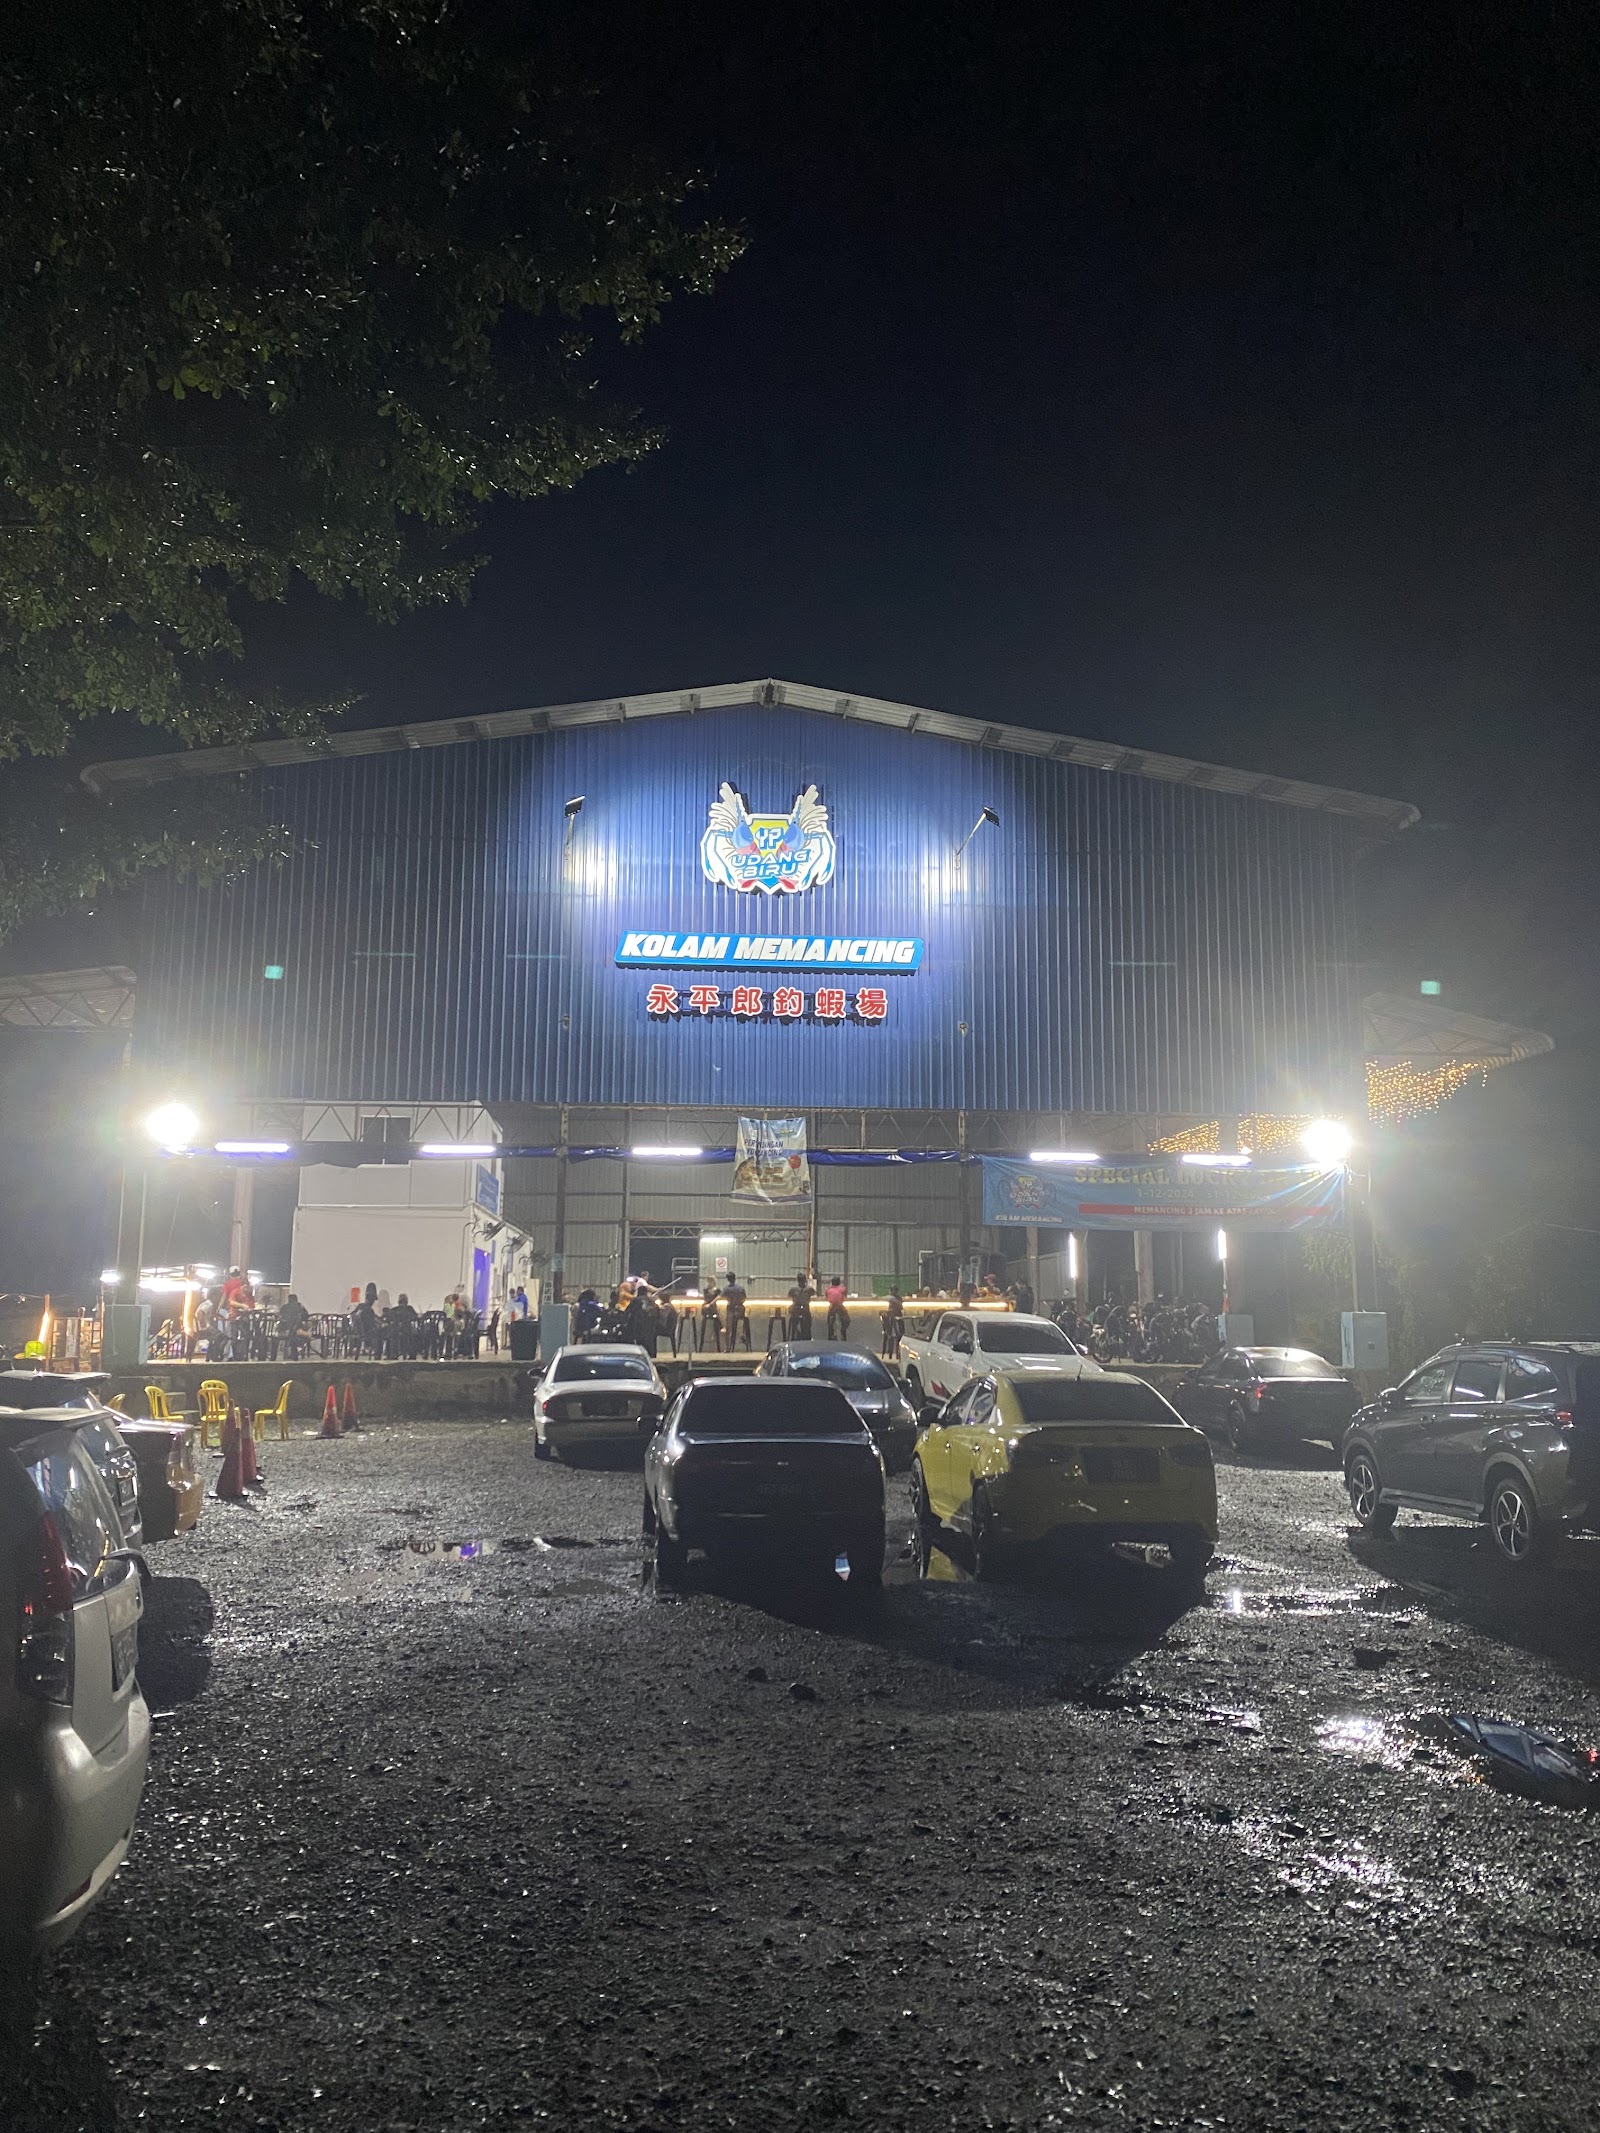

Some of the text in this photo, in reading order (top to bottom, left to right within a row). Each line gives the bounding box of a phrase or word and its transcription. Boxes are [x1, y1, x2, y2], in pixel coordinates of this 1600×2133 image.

[755, 828, 784, 849] YP
[732, 849, 809, 868] UDANG
[742, 864, 799, 878] BIRU
[620, 934, 916, 964] KOLAM MEMANCING
[646, 984, 888, 1018] 永平郎釣蝦場
[1074, 1167, 1169, 1184] SPECIAL
[1137, 1188, 1194, 1199] 1-12-2024
[1134, 1206, 1185, 1215] MEMANCING
[1194, 1207, 1212, 1216] JAM
[1213, 1207, 1225, 1216] KE
[1226, 1207, 1247, 1216] ATAS
